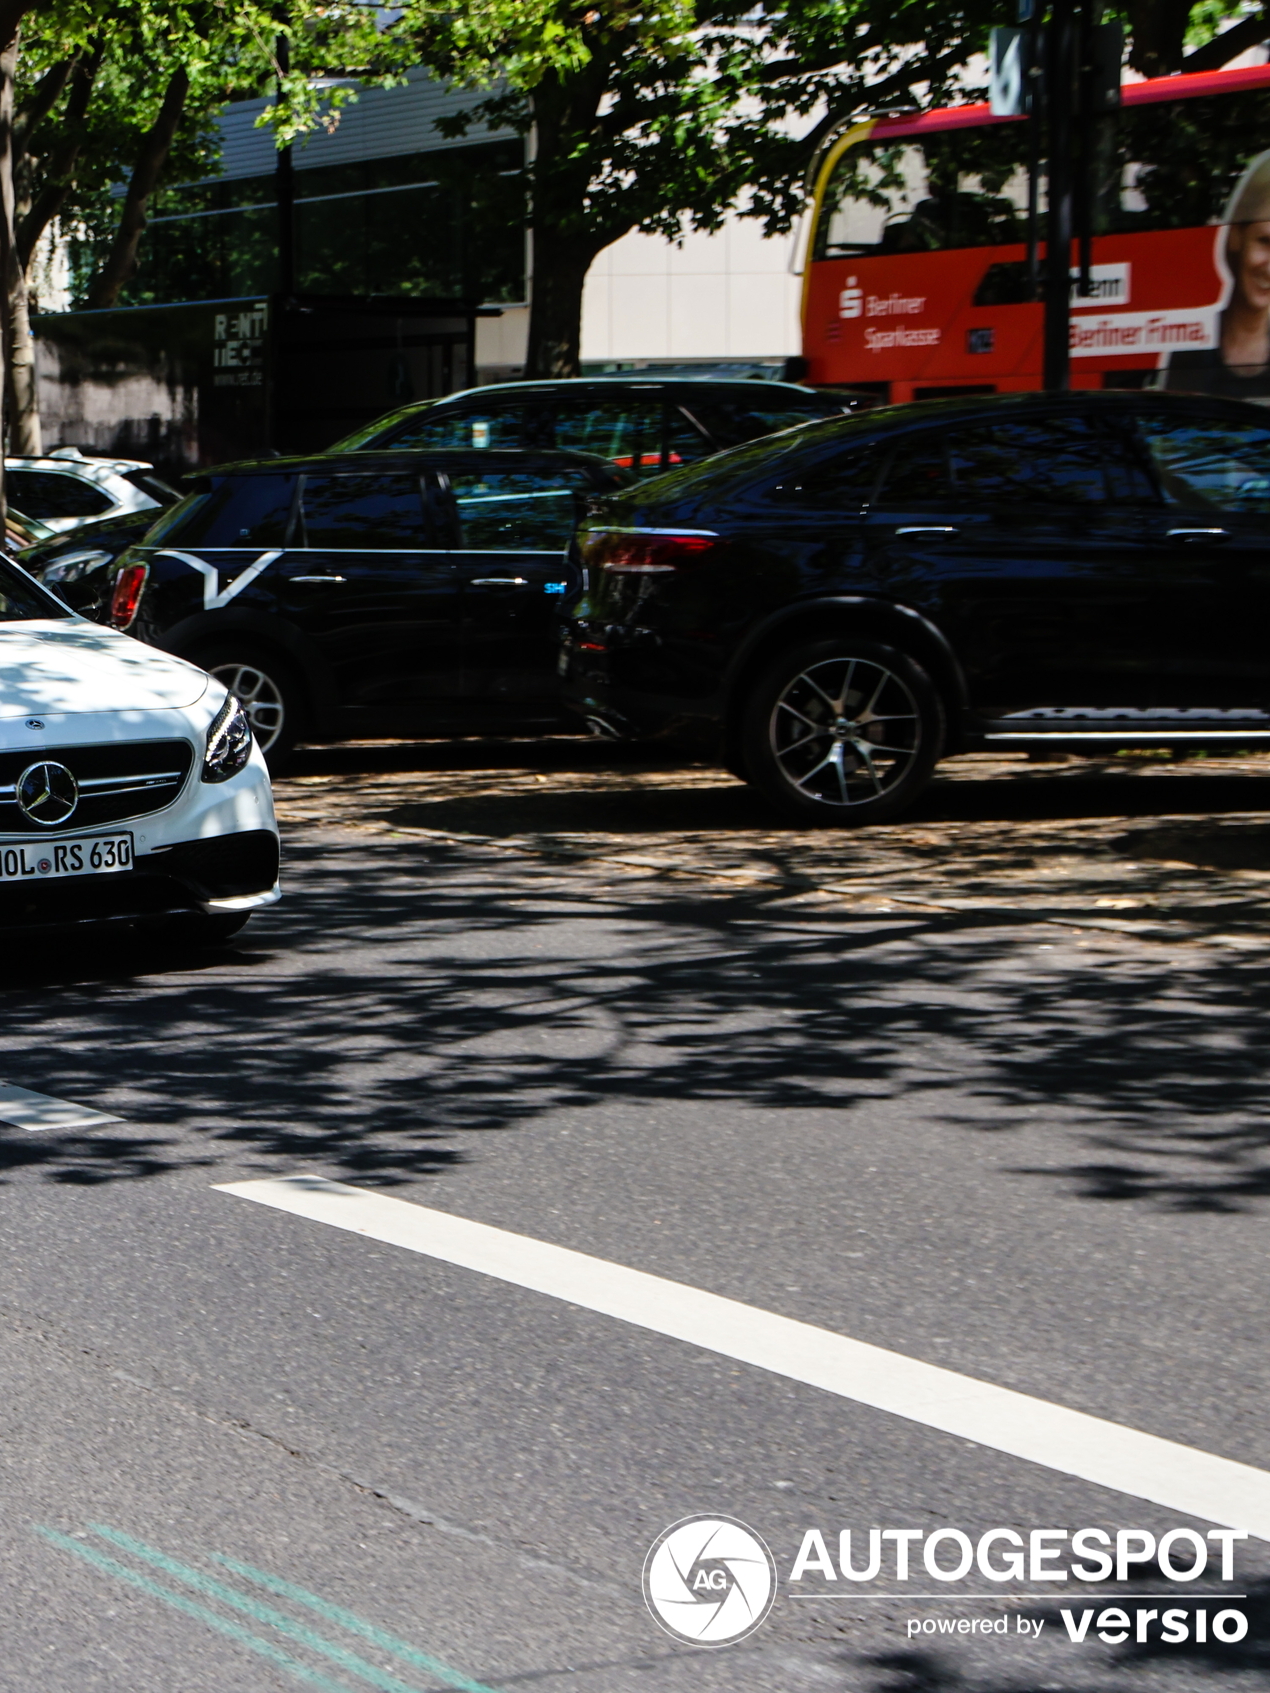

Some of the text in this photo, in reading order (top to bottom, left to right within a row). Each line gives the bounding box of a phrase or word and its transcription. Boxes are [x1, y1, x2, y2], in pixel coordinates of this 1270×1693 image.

[866, 293, 927, 317] Berliner
[864, 325, 942, 354] Sparkasse
[54, 844, 84, 873] RS
[89, 839, 130, 869] 630
